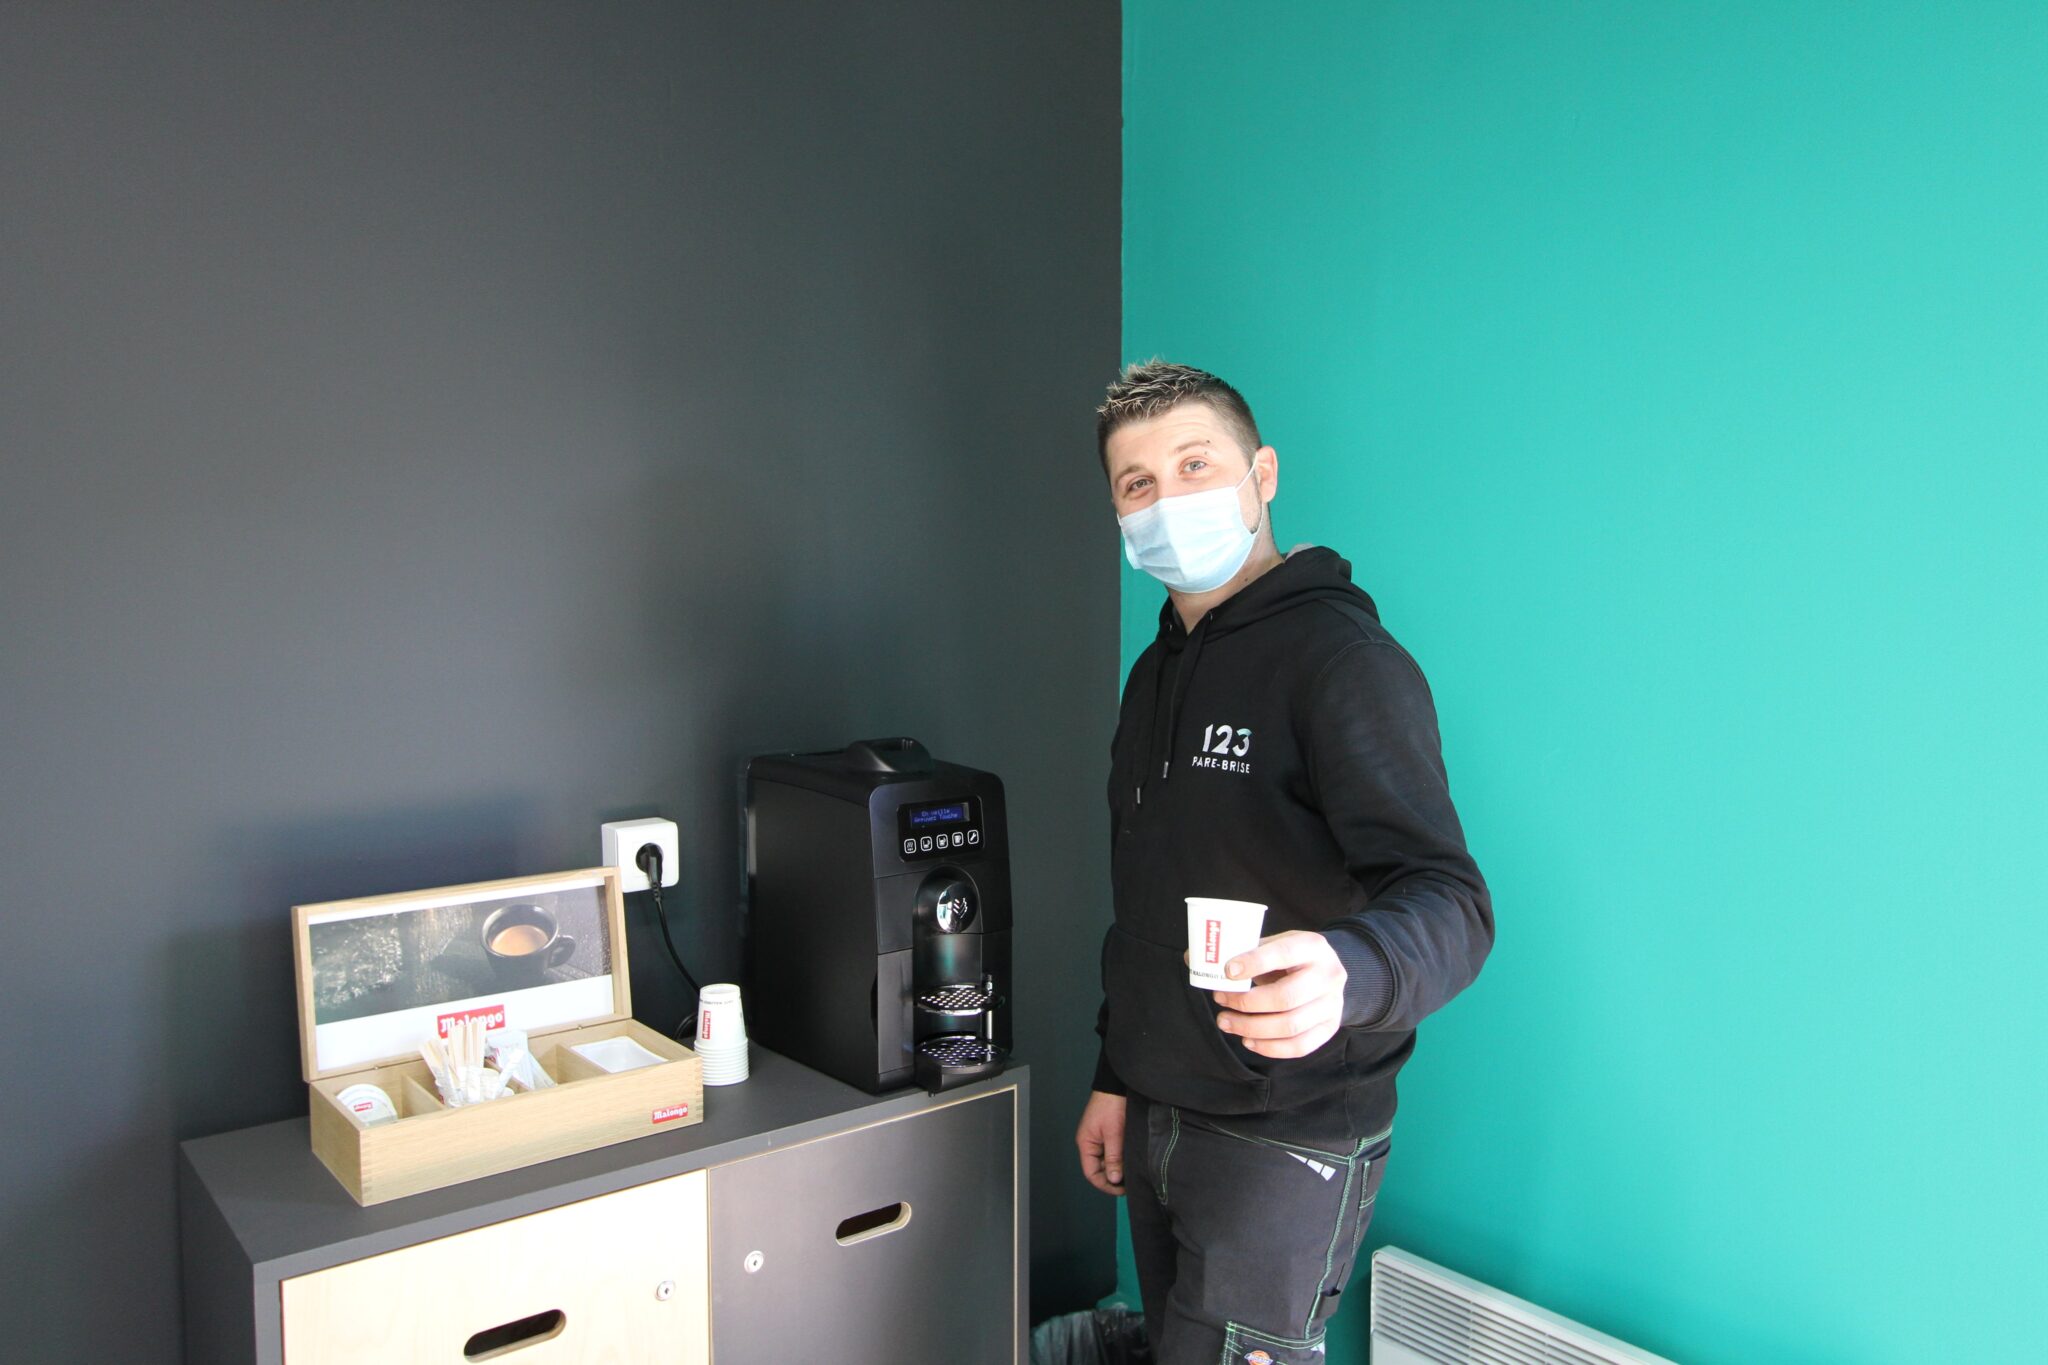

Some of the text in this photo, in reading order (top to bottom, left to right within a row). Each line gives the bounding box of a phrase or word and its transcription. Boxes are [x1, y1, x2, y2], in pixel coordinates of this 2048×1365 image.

[1202, 724, 1252, 757] 123
[1191, 756, 1251, 774] PARE-BRISE
[653, 1106, 688, 1121] Malongo
